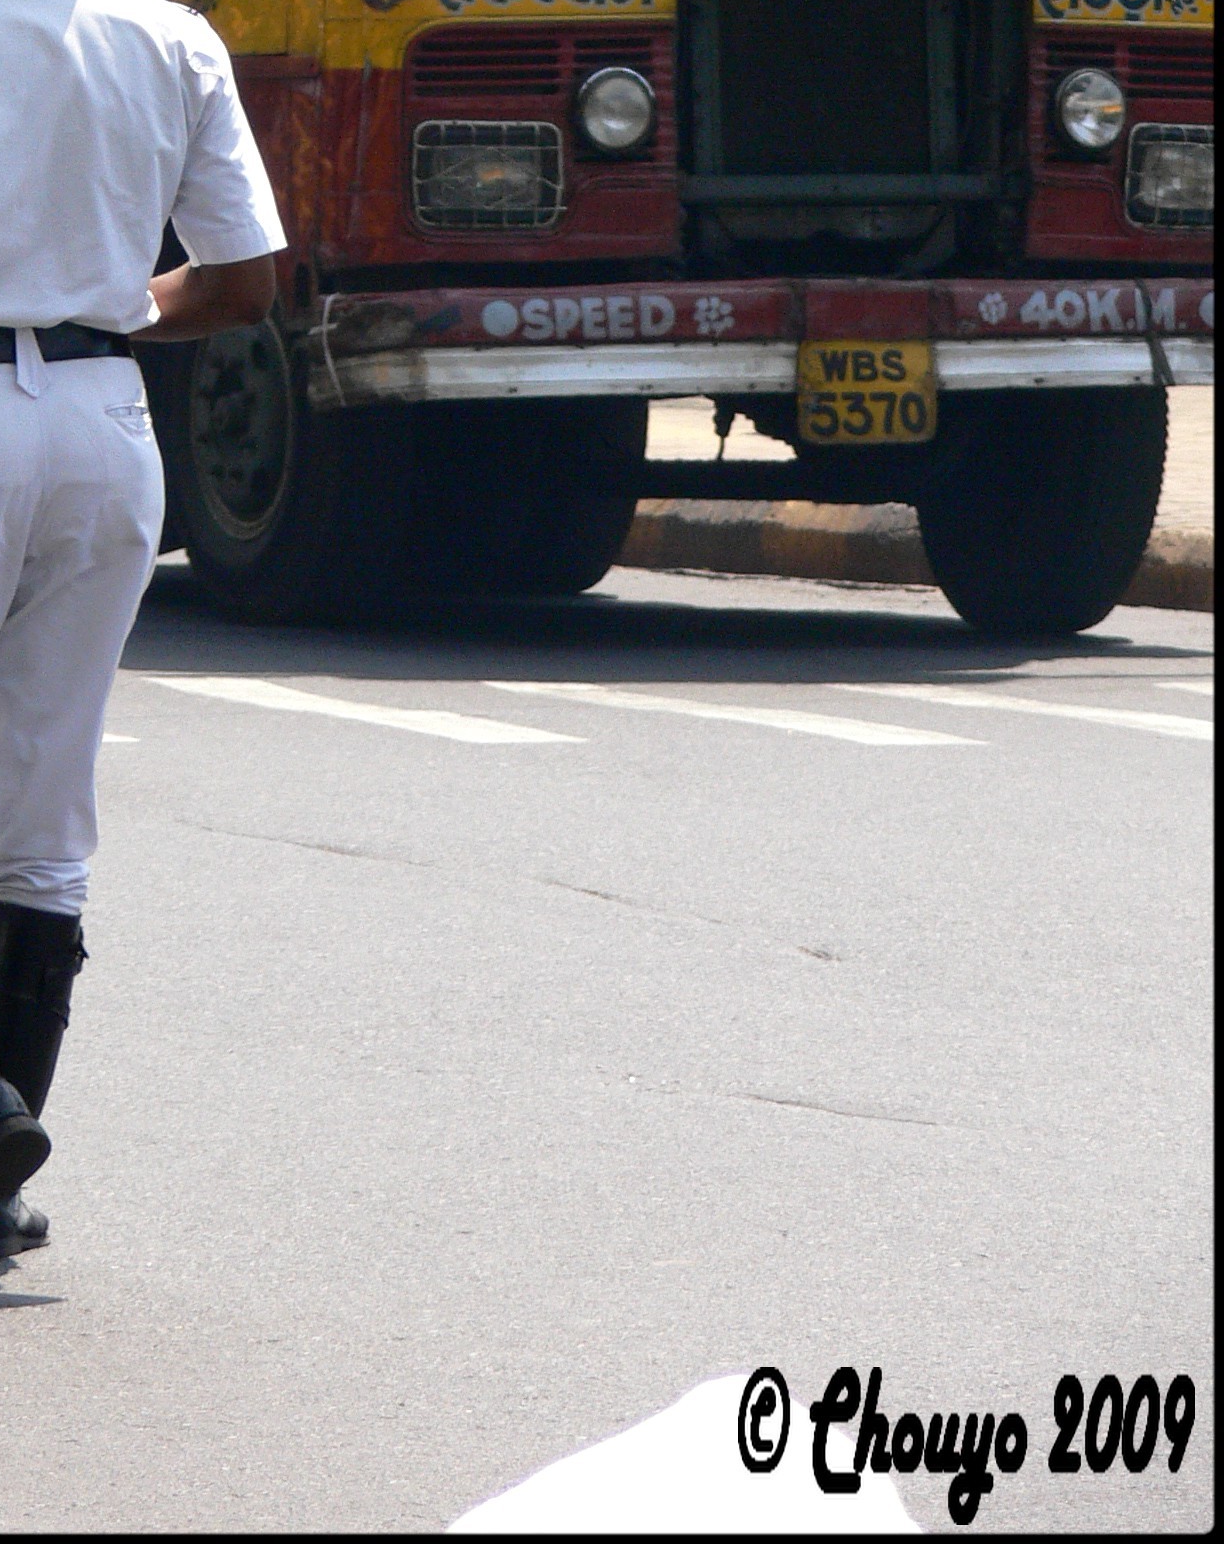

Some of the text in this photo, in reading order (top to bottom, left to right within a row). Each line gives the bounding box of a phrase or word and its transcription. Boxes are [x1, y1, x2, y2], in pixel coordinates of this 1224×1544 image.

[521, 294, 676, 340] SPEED
[817, 348, 906, 382] WBS
[809, 391, 927, 436] 5370
